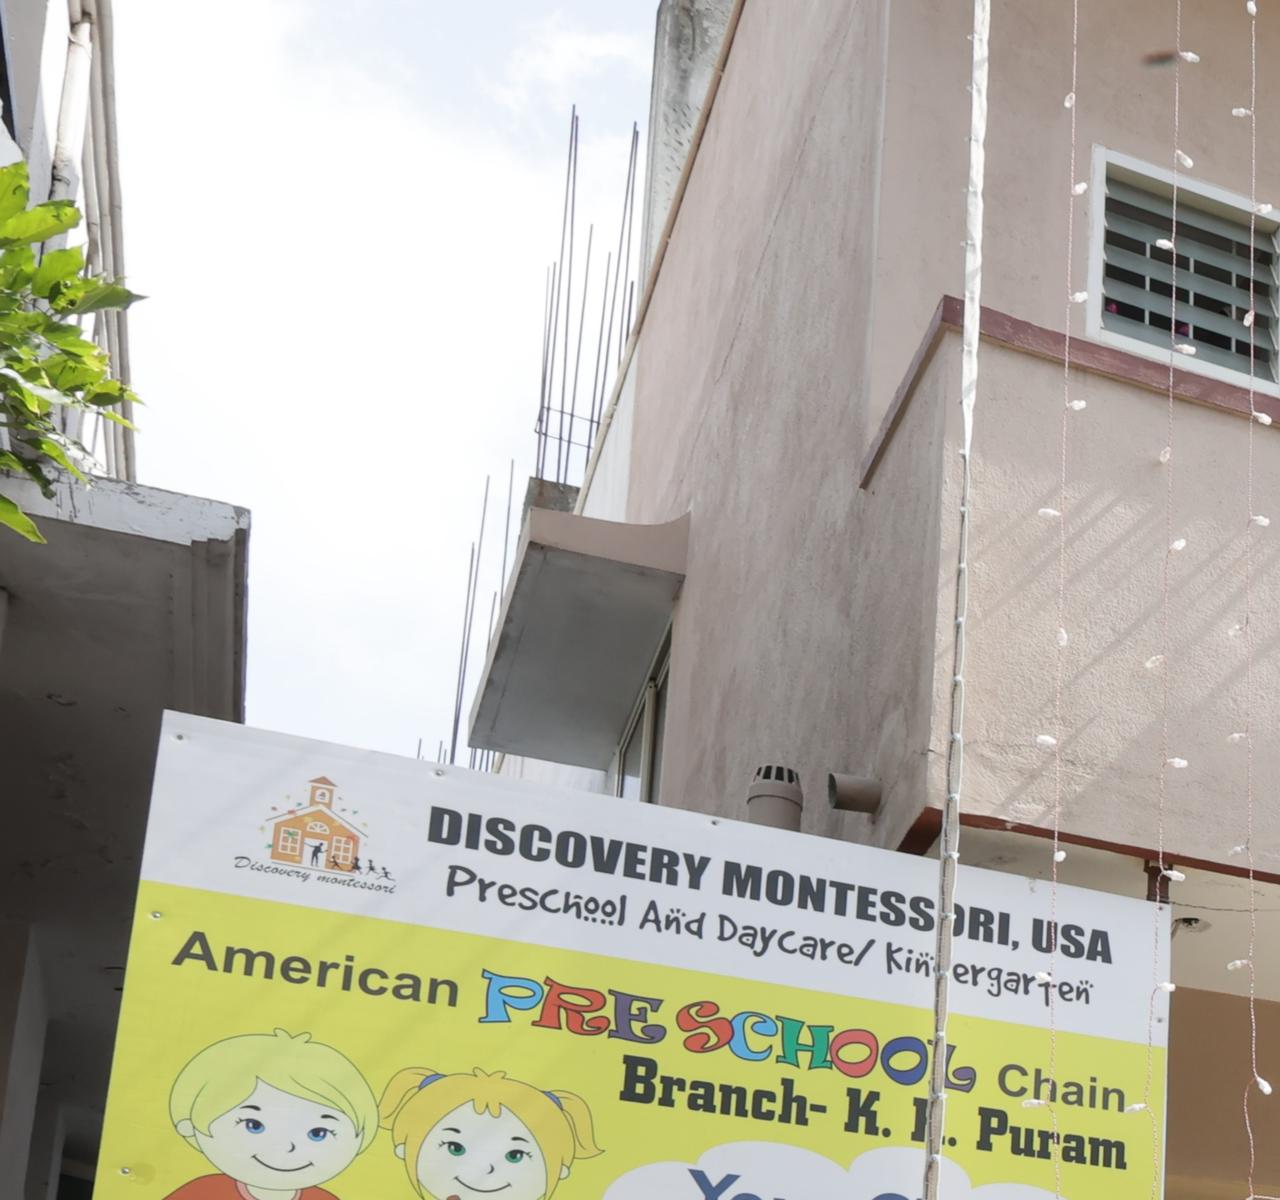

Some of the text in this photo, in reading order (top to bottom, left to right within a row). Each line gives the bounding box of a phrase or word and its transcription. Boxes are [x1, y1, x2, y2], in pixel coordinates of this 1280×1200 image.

[234, 856, 396, 894] Discovery montessori
[427, 806, 711, 890] DISCOVERY
[1032, 917, 1113, 964] USA
[446, 864, 1093, 1006] Preschool And Daycare/ Kinergarten
[171, 930, 1126, 1112] American PRE SCHOOL Chain
[620, 1054, 827, 1126] Branch-
[844, 1087, 891, 1137] K.
[976, 1107, 1127, 1170] Puram
